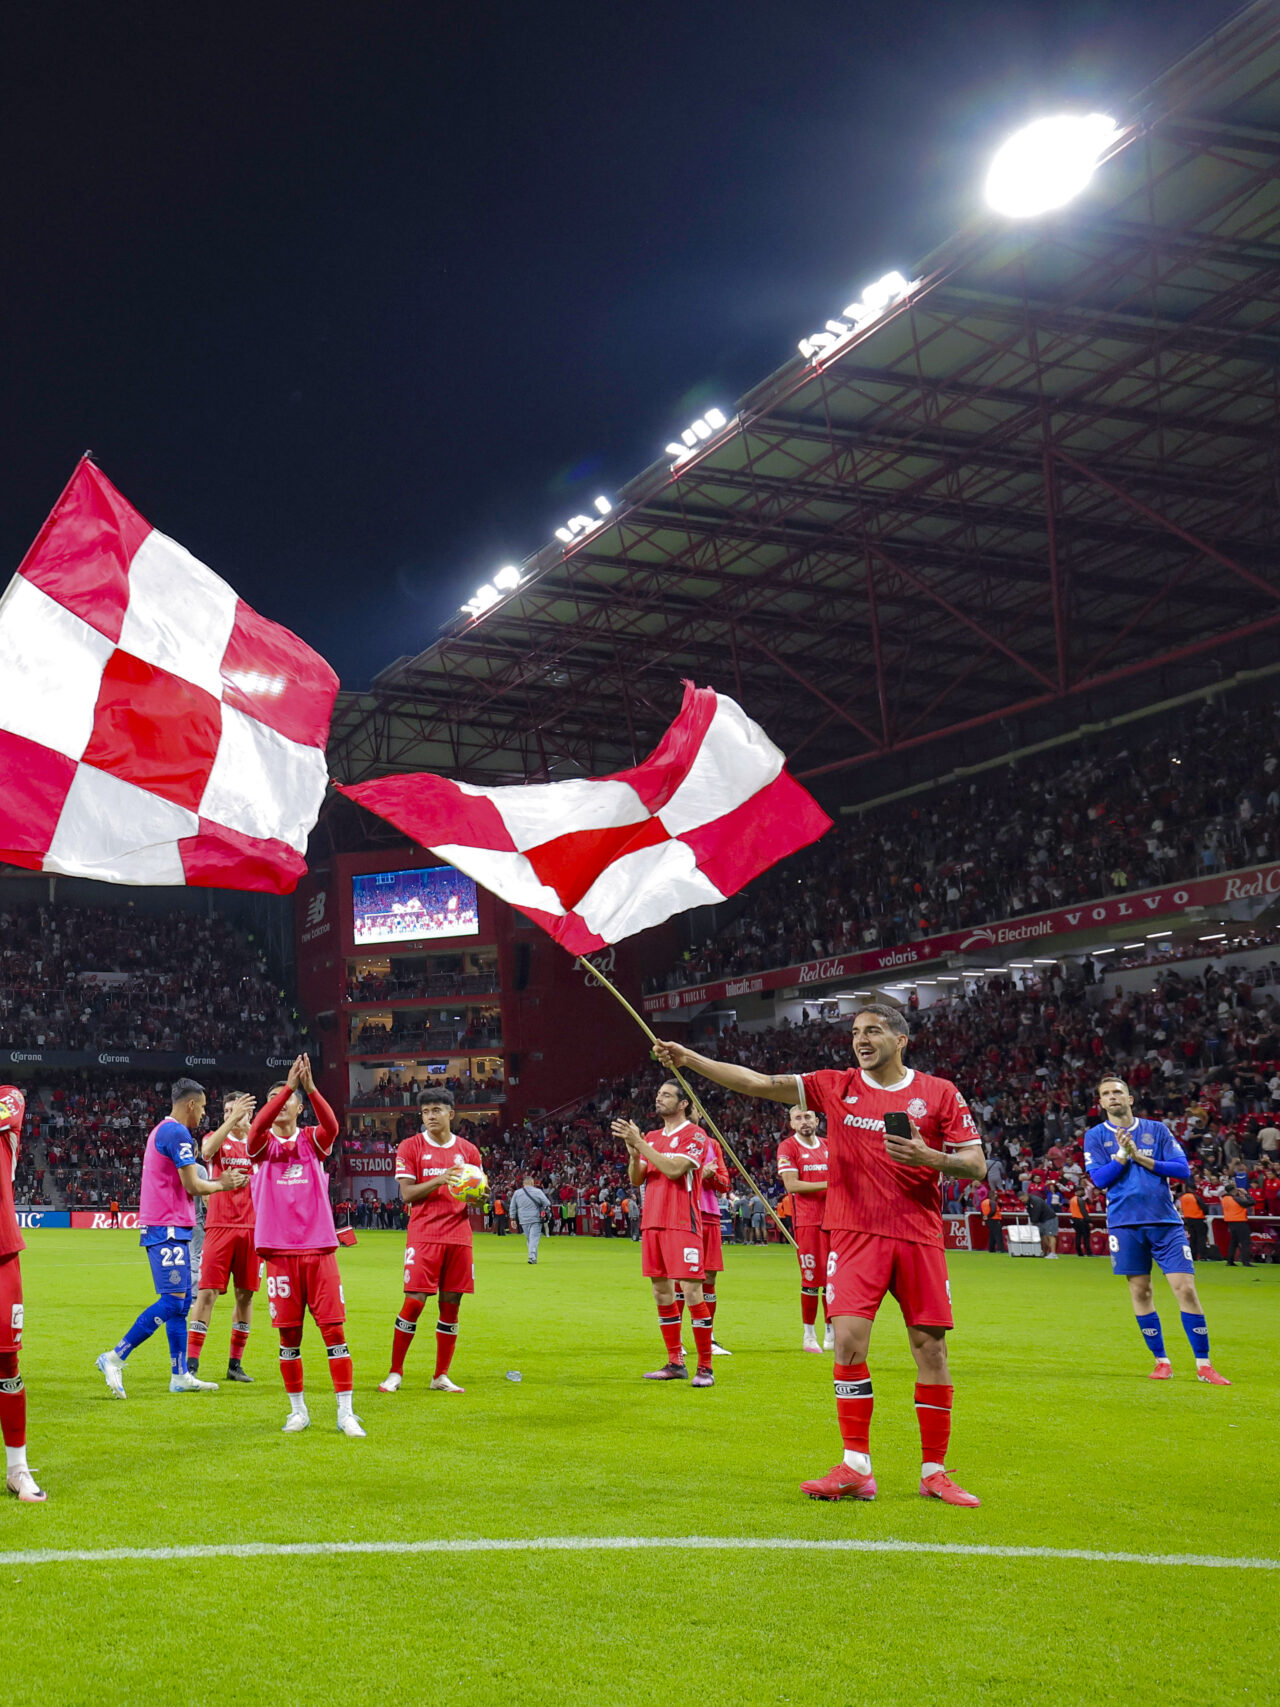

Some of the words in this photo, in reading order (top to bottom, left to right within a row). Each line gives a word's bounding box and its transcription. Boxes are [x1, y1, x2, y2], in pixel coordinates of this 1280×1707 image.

[1223, 872, 1263, 901] Red
[1065, 891, 1189, 925] VOLVO
[998, 920, 1053, 943] Electrolit
[878, 948, 918, 968] volaris
[798, 963, 819, 983] Red
[820, 960, 844, 979] Cola
[10, 1051, 42, 1063] Corona
[98, 1053, 130, 1064] Corona
[185, 1056, 217, 1067] Corona
[266, 1057, 295, 1068] Coron
[844, 1114, 886, 1133] ROSHF
[350, 1158, 393, 1171] ESTADIO
[160, 1247, 186, 1267] 22
[800, 1254, 816, 1269] 16
[267, 1276, 291, 1298] 85
